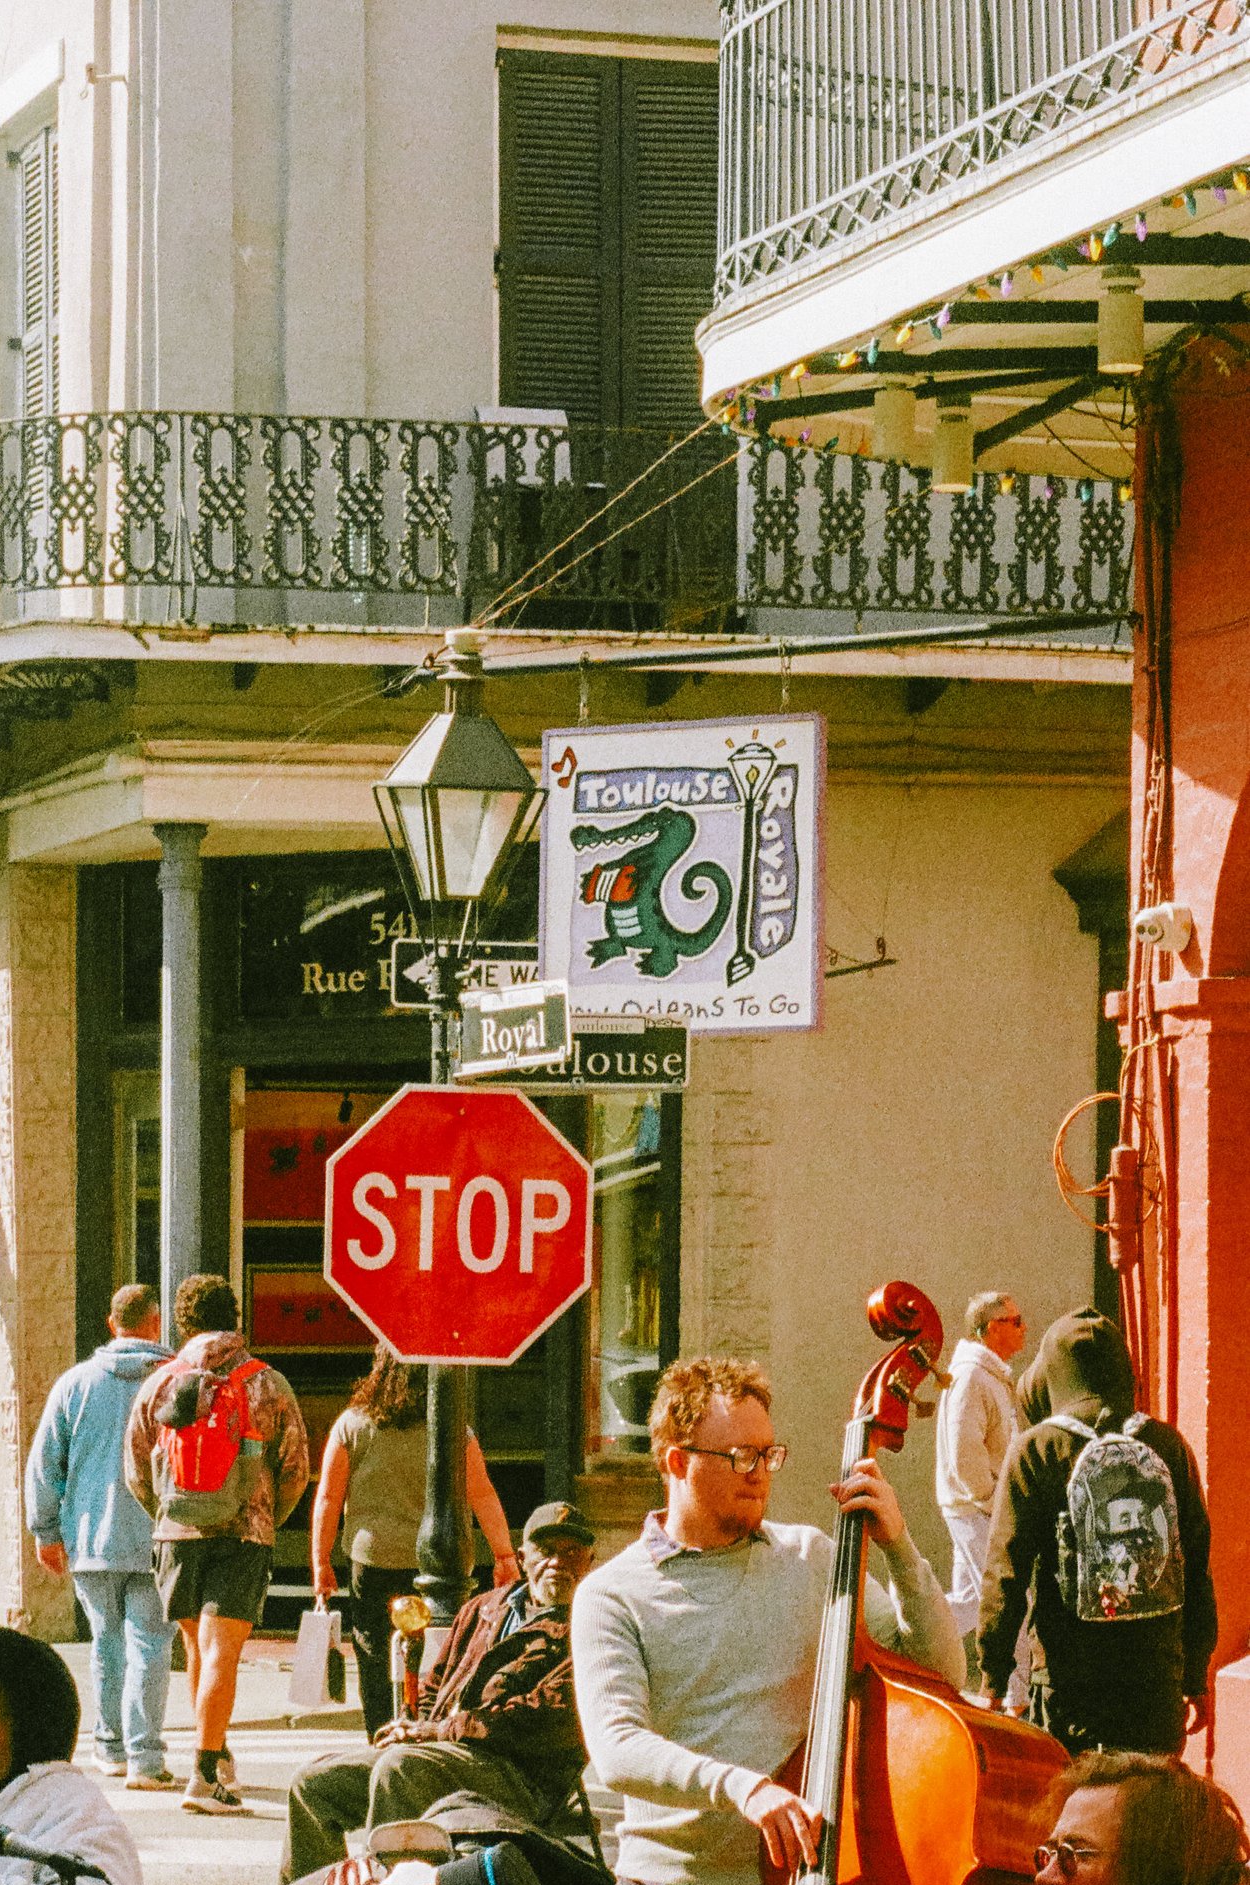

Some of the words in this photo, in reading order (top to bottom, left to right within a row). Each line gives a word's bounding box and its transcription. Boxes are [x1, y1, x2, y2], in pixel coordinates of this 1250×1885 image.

[579, 771, 731, 810] Toulouse
[759, 775, 794, 948] Royale
[301, 962, 367, 994] Rue
[733, 998, 759, 1016] To
[769, 994, 800, 1014] Go
[481, 1010, 546, 1057] Royal
[520, 1040, 683, 1076] ulouse
[347, 1172, 571, 1274] STOP
